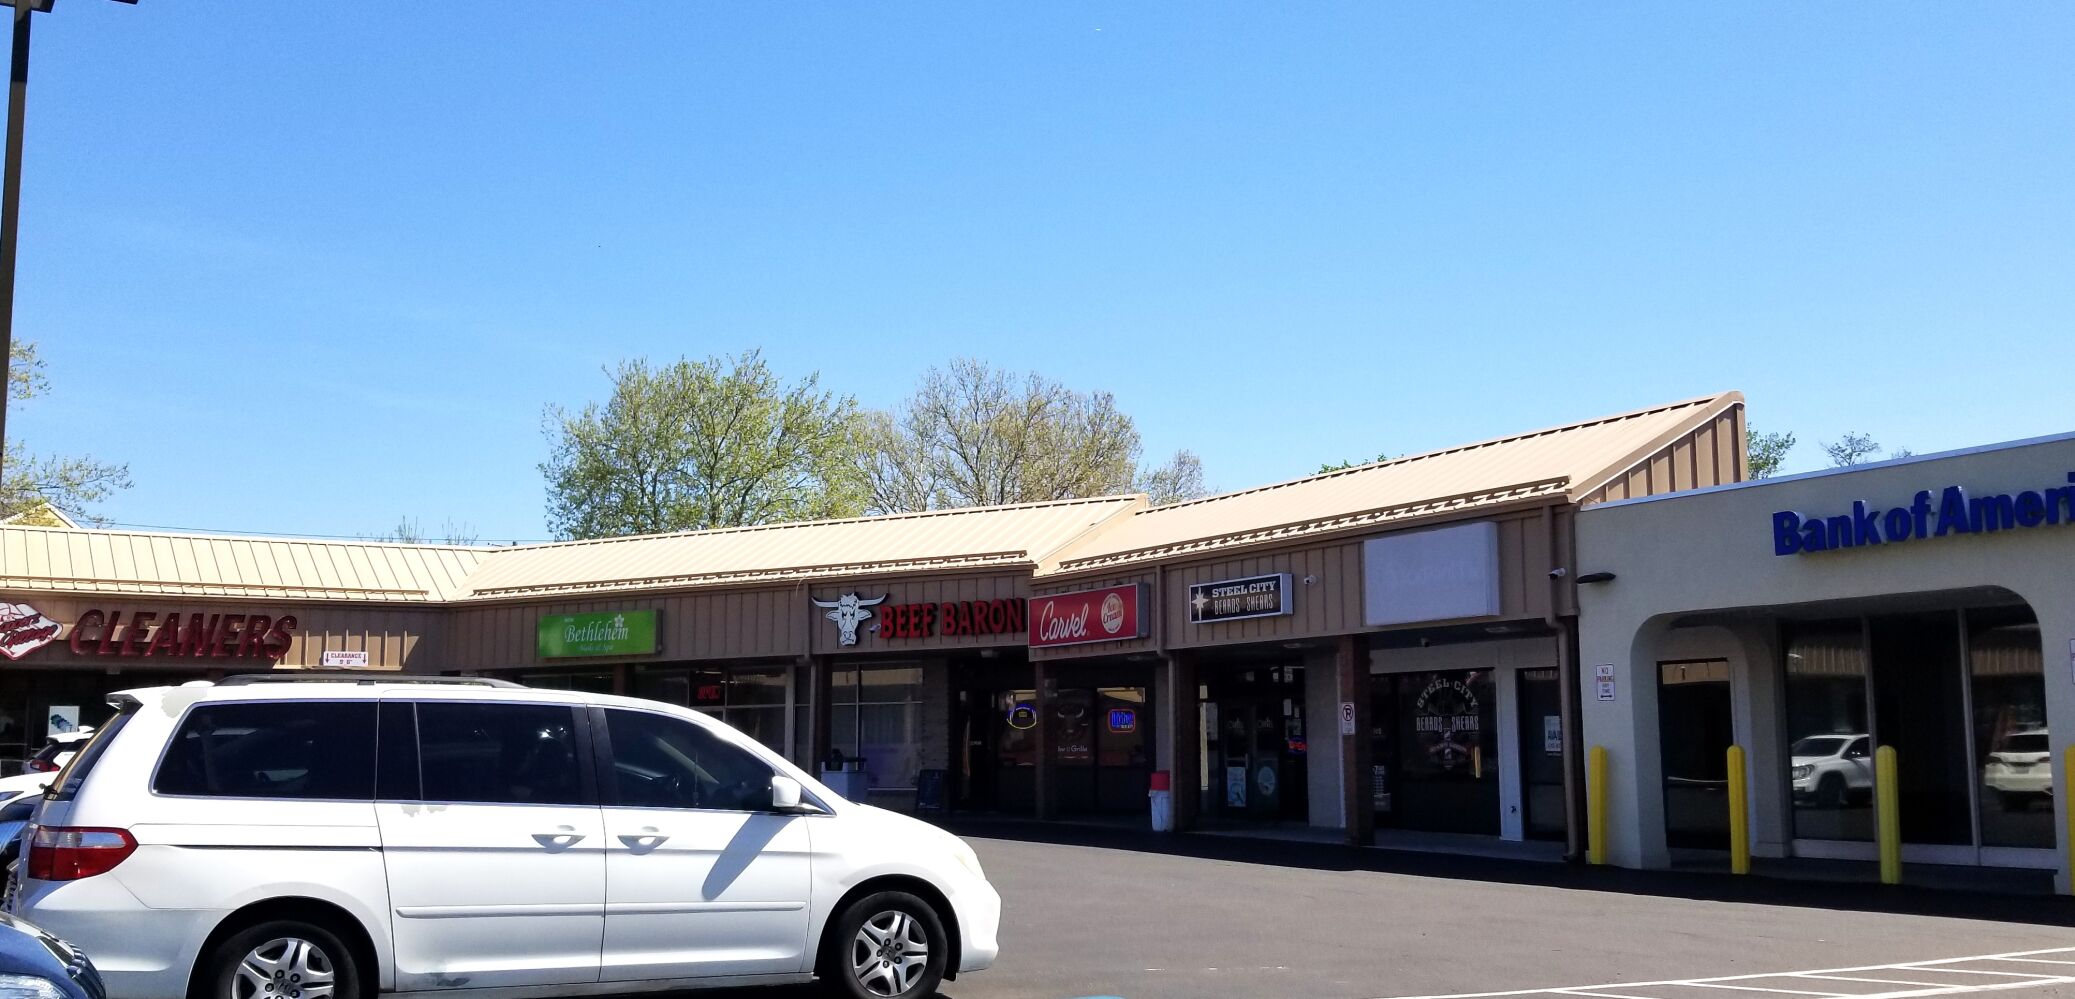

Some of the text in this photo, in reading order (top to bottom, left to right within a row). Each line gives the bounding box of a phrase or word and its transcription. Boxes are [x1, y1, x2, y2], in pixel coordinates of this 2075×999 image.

[1773, 500, 1881, 556] Bank
[1885, 489, 1932, 543] of
[1212, 581, 1276, 598] STEEL CITY
[1214, 594, 1273, 615] BEARDS SHEARS
[70, 609, 297, 658] CLEANERS
[565, 621, 629, 643] Bethlehem
[880, 598, 1026, 639] BEEF BARON
[1040, 600, 1089, 642] Carvel
[1417, 678, 1479, 708] STEEL CITY
[1416, 715, 1479, 732] BEARDS SHEARS
